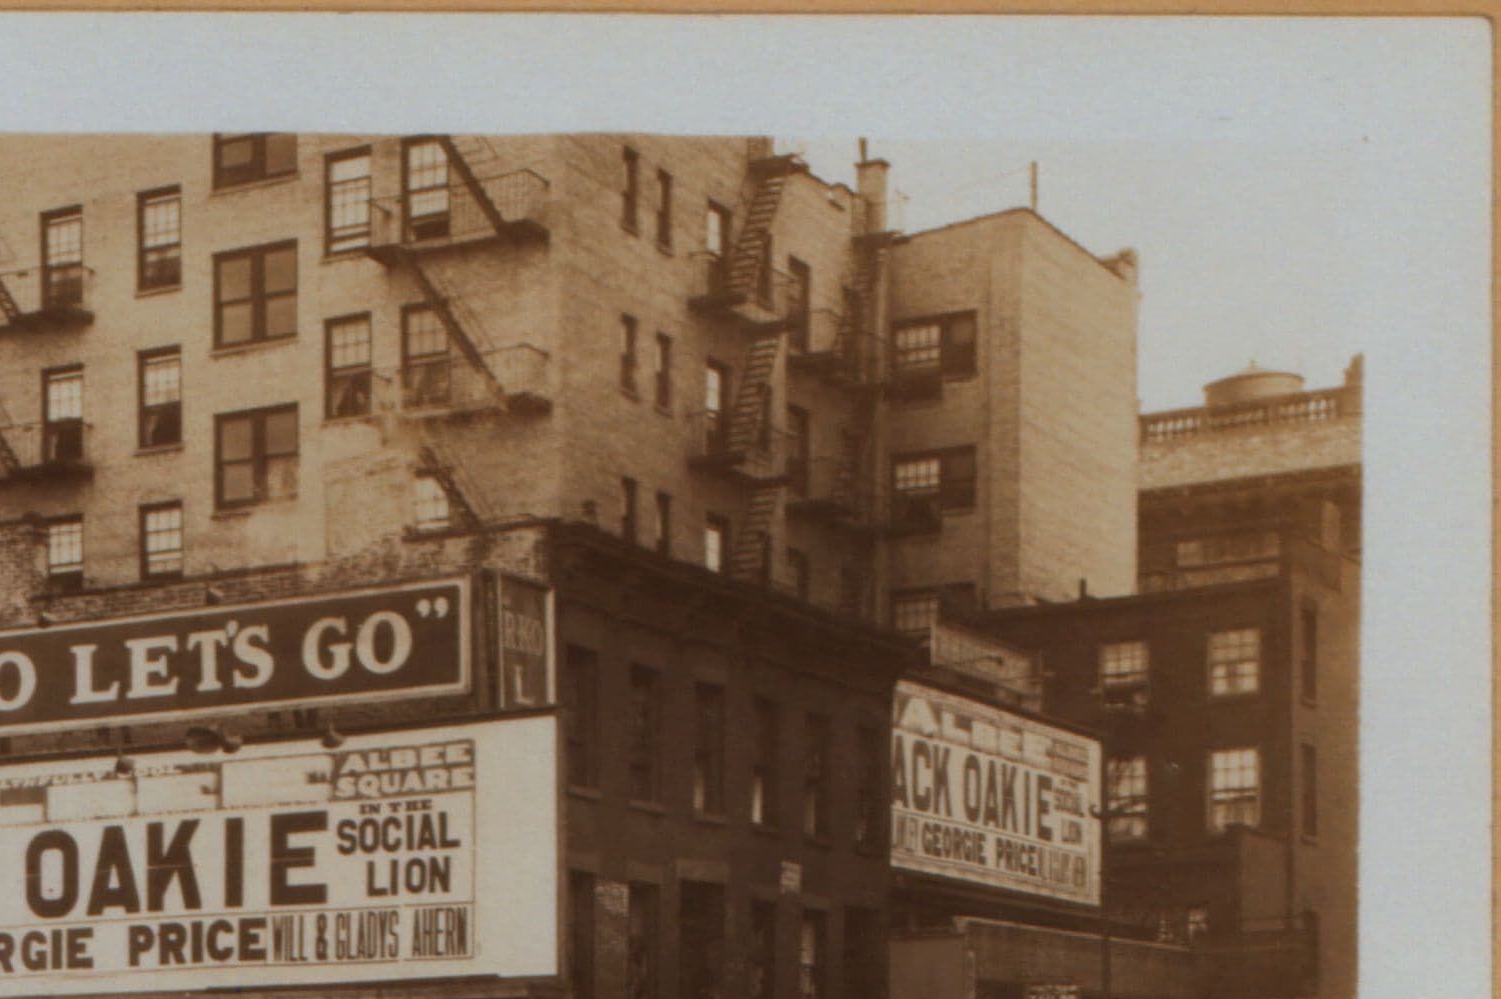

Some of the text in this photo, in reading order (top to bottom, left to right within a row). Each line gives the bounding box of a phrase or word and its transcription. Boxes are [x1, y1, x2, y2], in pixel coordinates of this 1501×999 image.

[70, 620, 275, 706] LET'S
[339, 741, 472, 775] ALBEE
[335, 768, 474, 799] SQUARE
[359, 800, 433, 815] IN THE
[963, 755, 1052, 842] OAKIE
[337, 812, 460, 855] SOCIAL
[921, 822, 987, 865] GEORGIE
[996, 837, 1037, 877] PRICE
[25, 811, 328, 919] OAKIE
[366, 857, 450, 897] LION
[128, 917, 267, 967] PRICE
[273, 907, 467, 961] WILL & GLADYS AHERN
